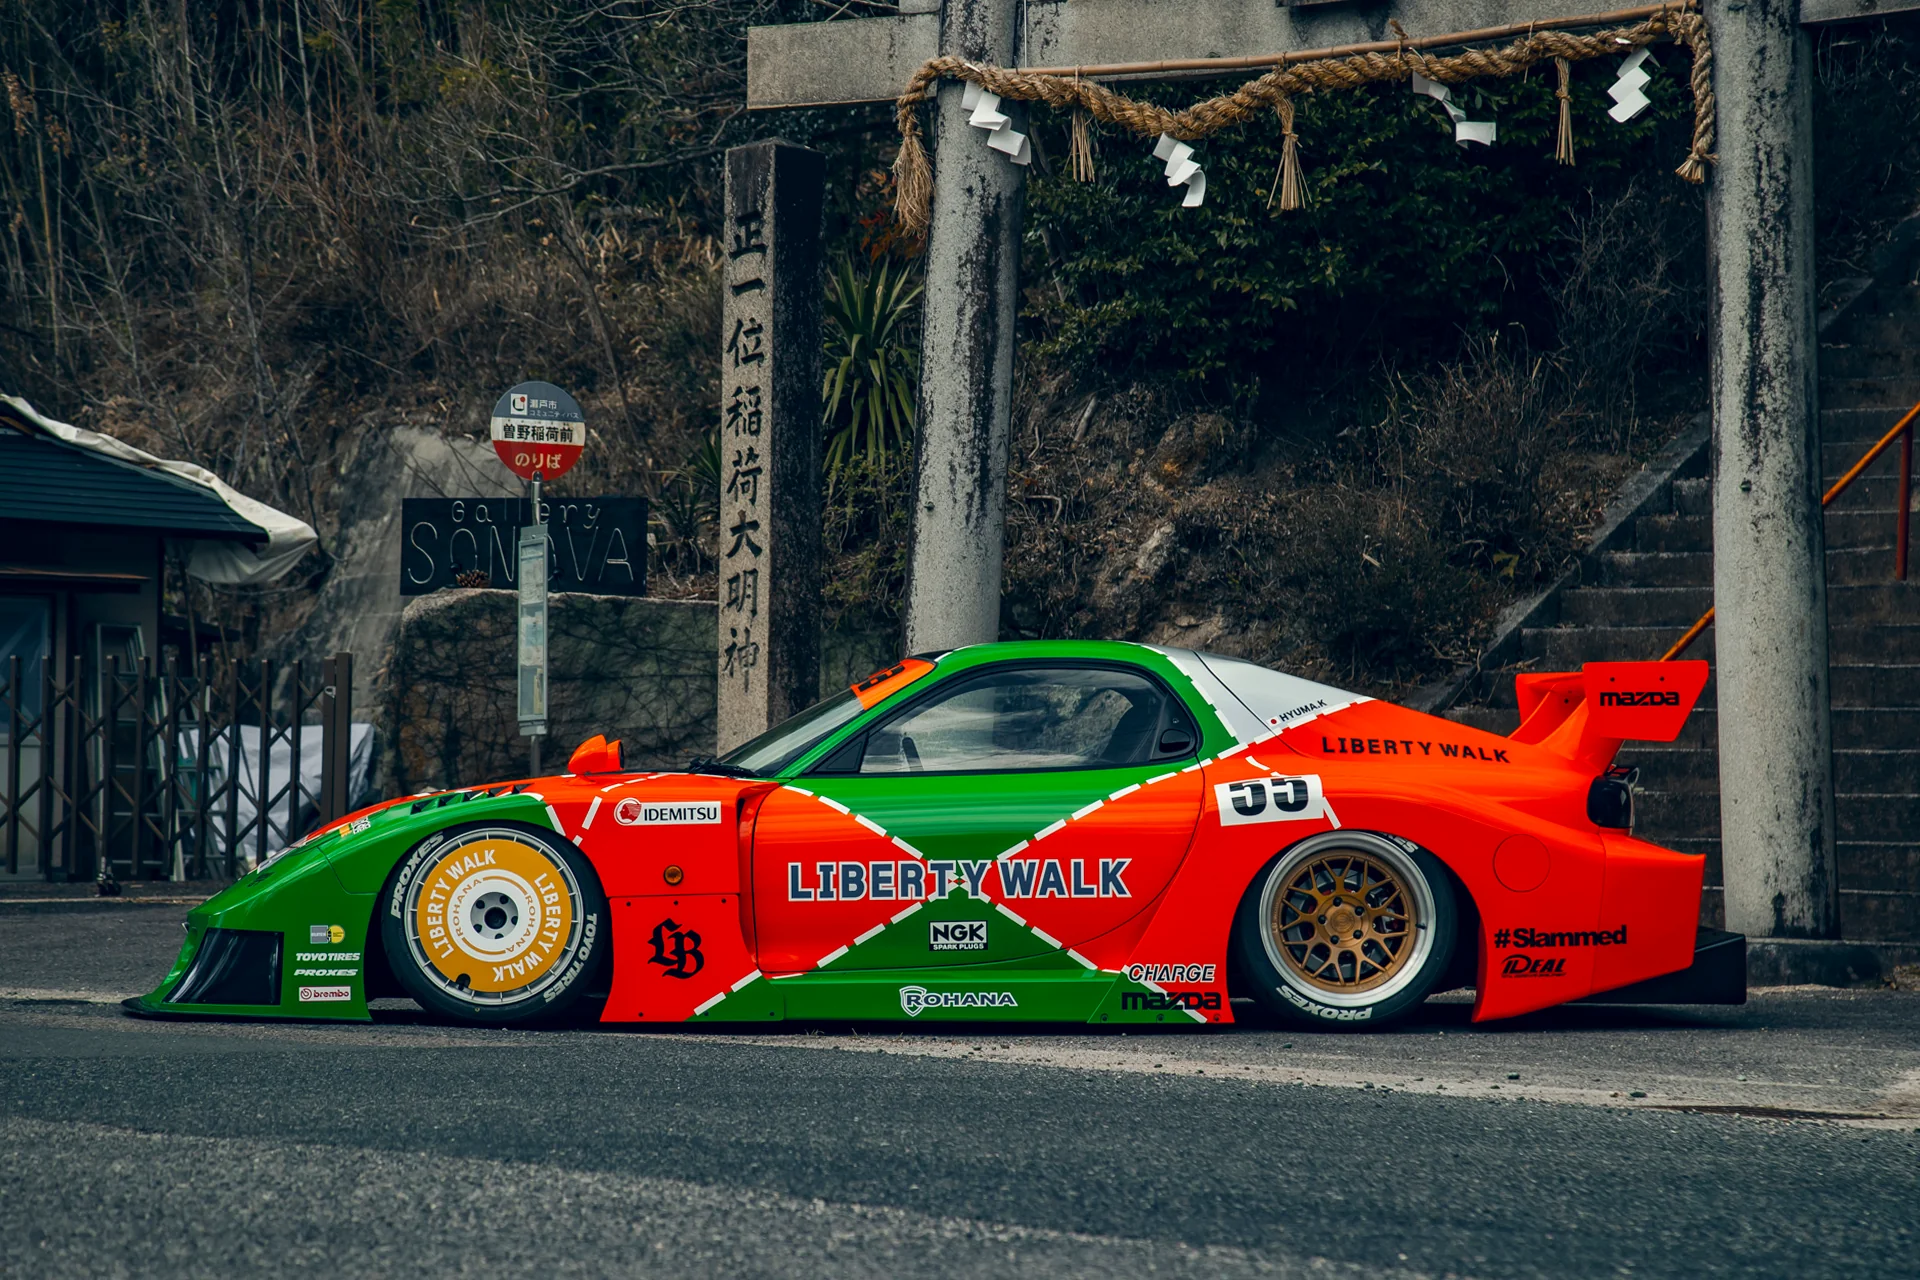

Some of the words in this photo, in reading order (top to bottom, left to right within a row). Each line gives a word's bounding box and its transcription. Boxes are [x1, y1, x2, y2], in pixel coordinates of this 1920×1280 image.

[503, 423, 573, 443] 曽野稲荷前
[515, 453, 561, 469] のりば
[1279, 699, 1327, 722] HYUMA.K
[1322, 736, 1432, 756] LIBERTY
[1439, 743, 1511, 763] WALK
[1228, 776, 1309, 817] 55
[644, 807, 717, 822] IDEMITSU
[390, 831, 445, 919] PROXES
[788, 859, 992, 902] LIBERTY
[998, 857, 1133, 899] WALK
[427, 877, 454, 959] LIBERTY
[445, 849, 496, 880] WALK
[452, 878, 482, 939] ROHANA
[534, 873, 561, 954] LIBERTY
[505, 895, 536, 954] ROHANA
[578, 913, 598, 961] TOYO
[933, 923, 984, 942] NGK
[1494, 924, 1627, 949] #Slammed
[295, 952, 327, 961] TOYO
[328, 952, 360, 961] TIRES
[933, 943, 958, 951] SPARK
[293, 969, 358, 977] PROXES
[492, 951, 544, 983] WALK
[1128, 963, 1216, 983] CHARGE
[313, 989, 349, 998] brembo
[543, 961, 585, 1003] TIRES
[905, 992, 1018, 1007] ROHANA
[1276, 984, 1373, 1021] PROXES
